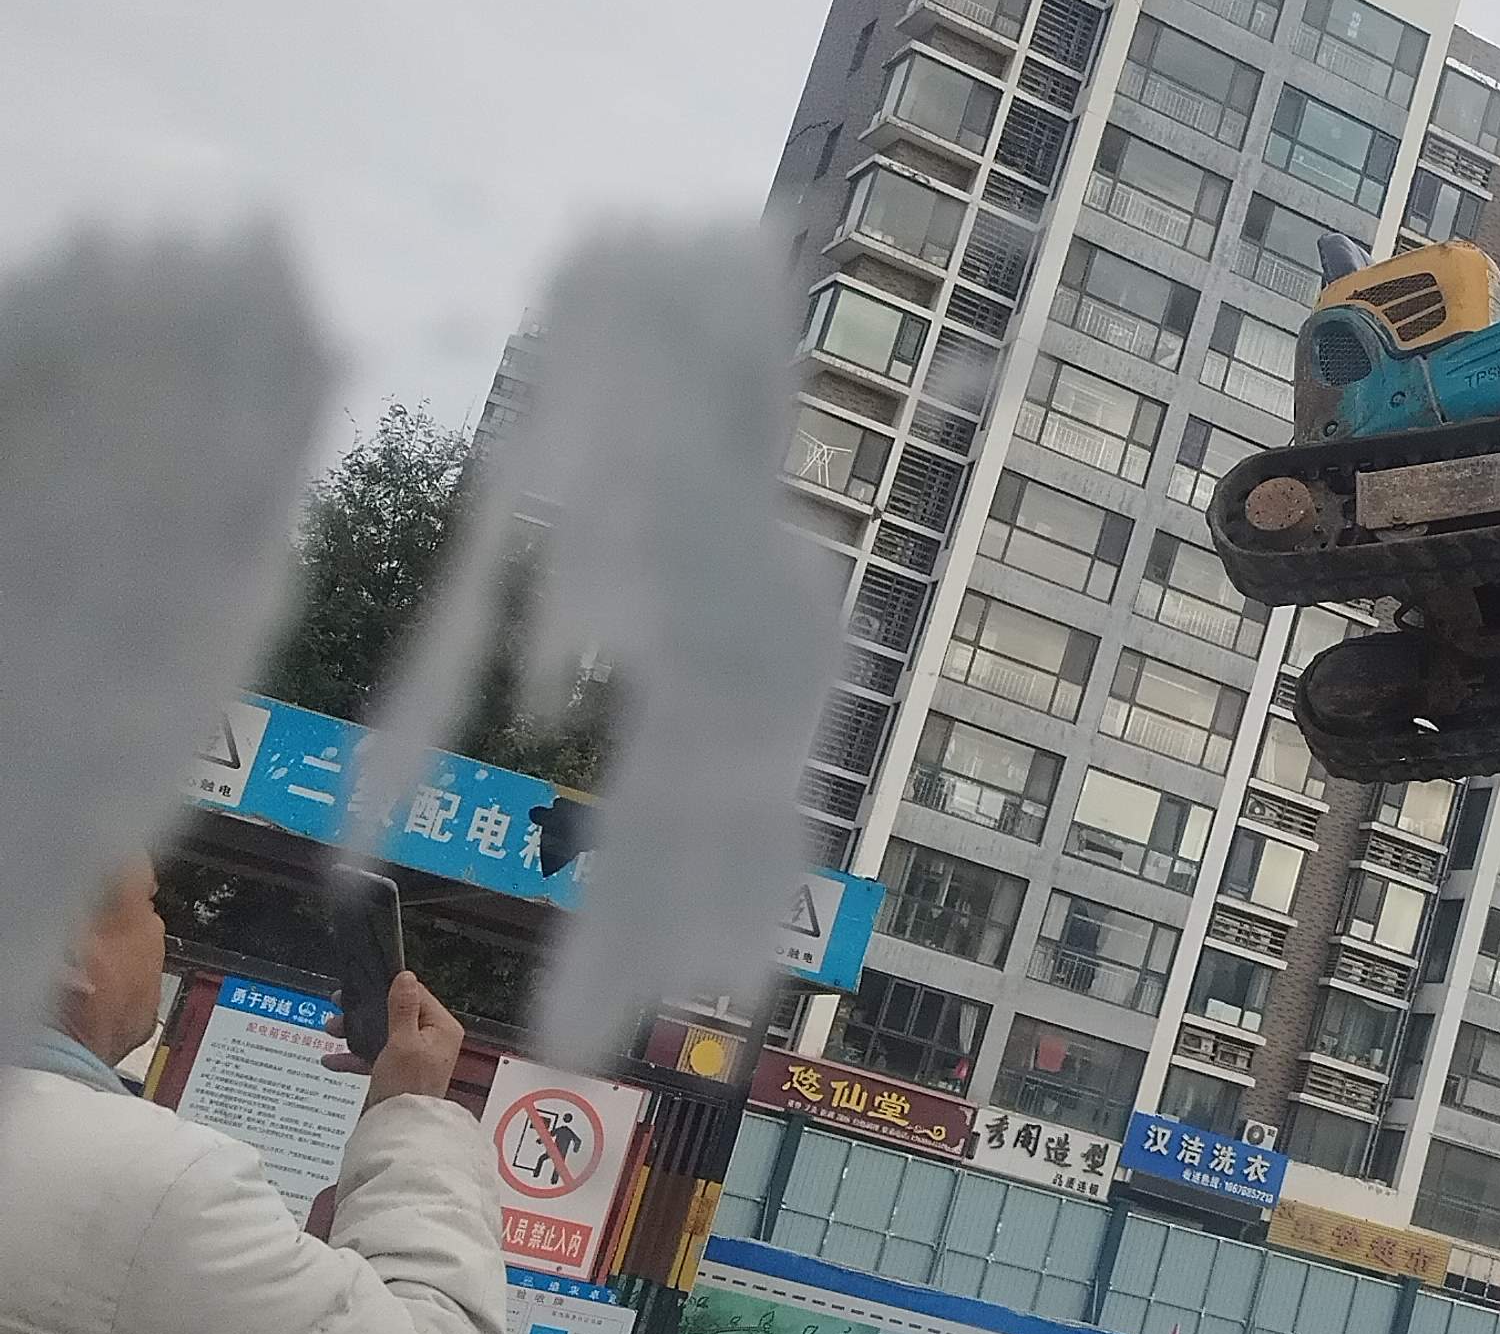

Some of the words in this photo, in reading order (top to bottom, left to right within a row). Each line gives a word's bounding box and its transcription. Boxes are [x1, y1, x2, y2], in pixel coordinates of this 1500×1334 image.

[230, 986, 293, 1017] 勇于跨越
[1142, 1123, 1271, 1184] 汉洁洗衣
[528, 1221, 583, 1259] 禁止入内
